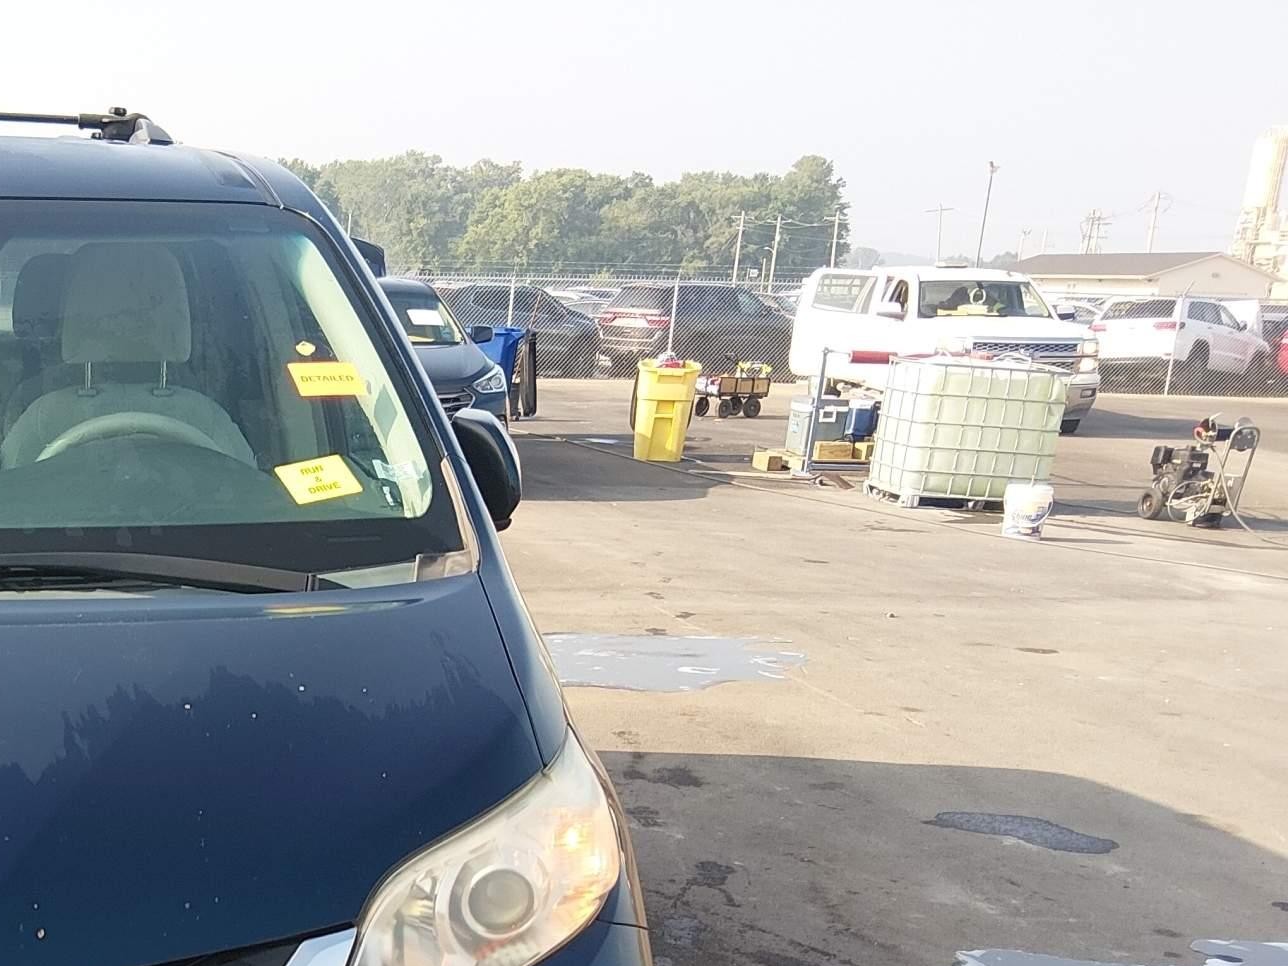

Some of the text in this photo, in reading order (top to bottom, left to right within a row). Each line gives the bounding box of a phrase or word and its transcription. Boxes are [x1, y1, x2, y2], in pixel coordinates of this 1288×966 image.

[300, 375, 355, 383] DETAILED
[300, 465, 324, 476] RUN
[308, 482, 342, 495] DRIVE
